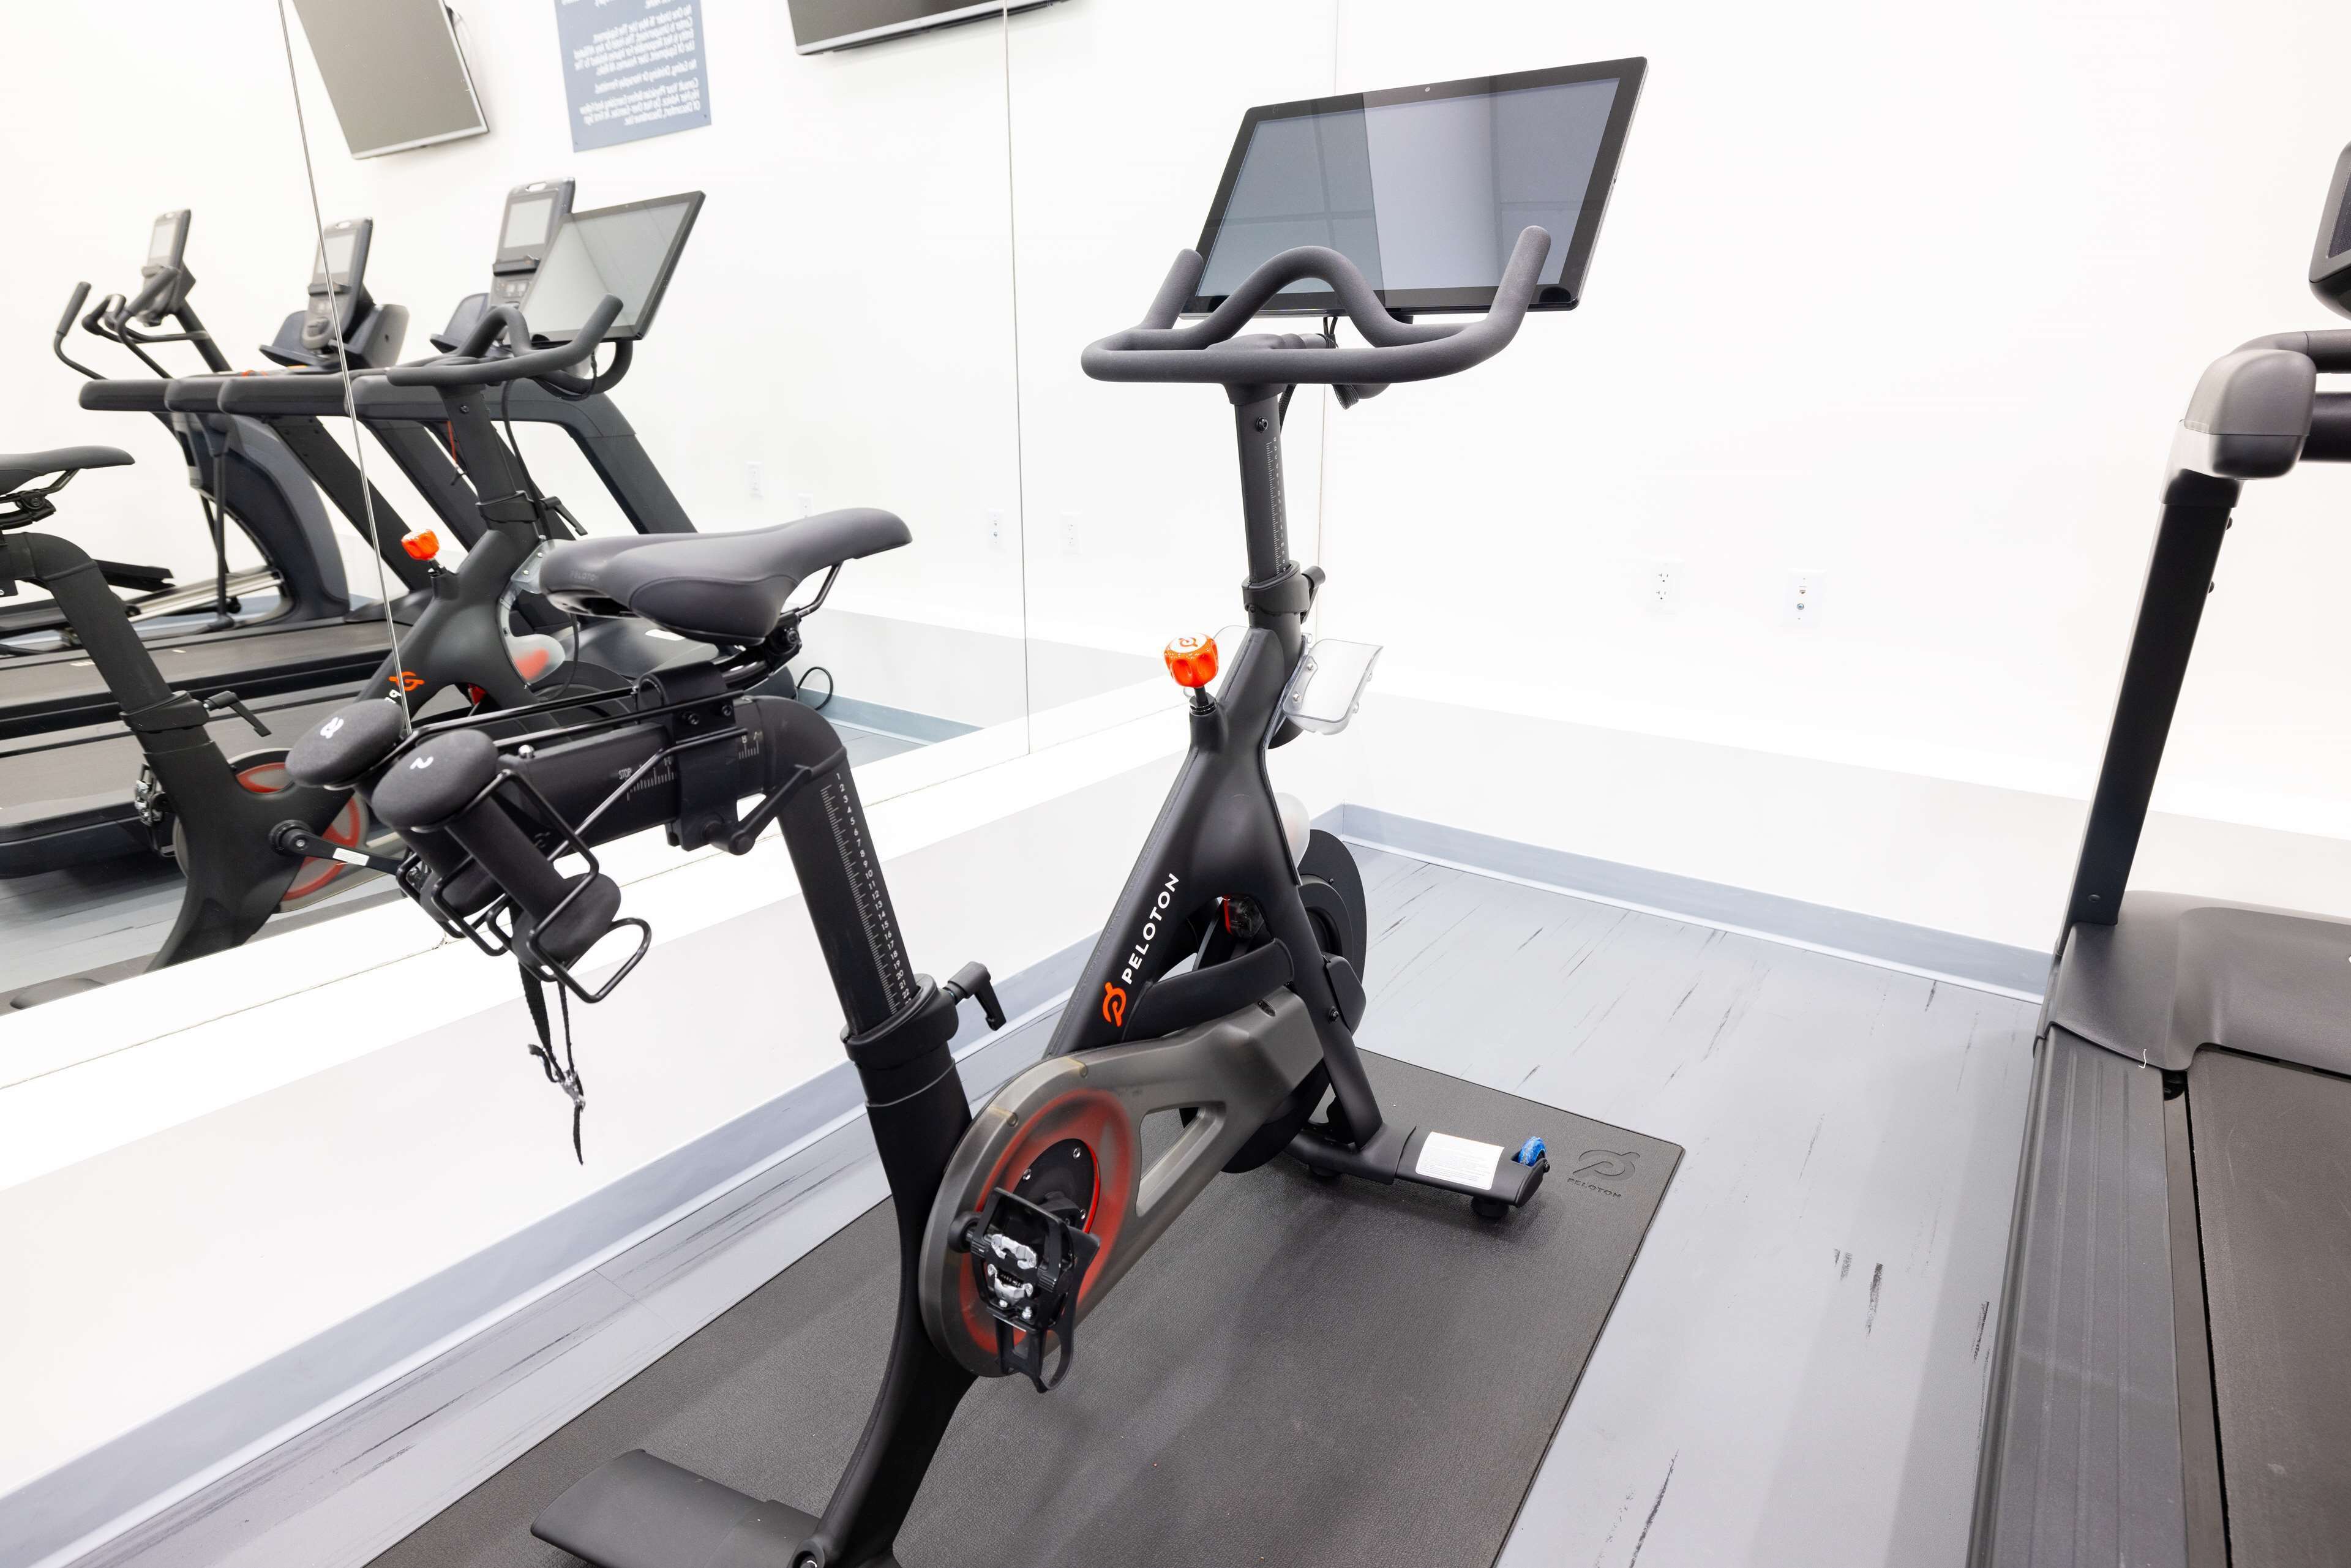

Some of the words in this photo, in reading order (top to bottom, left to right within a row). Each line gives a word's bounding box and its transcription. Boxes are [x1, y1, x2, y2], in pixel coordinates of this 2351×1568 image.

[618, 767, 632, 780] STOP
[839, 783, 845, 792] 2
[842, 795, 849, 803] 3
[850, 816, 855, 825] 5
[857, 838, 861, 847] 7
[860, 849, 865, 858] 8
[865, 869, 874, 880] 10
[868, 880, 876, 890] 11
[871, 890, 880, 900] 12
[874, 900, 883, 910] 13
[878, 910, 886, 921] 14
[881, 920, 889, 931] 15
[1121, 872, 1180, 985] PELOTON
[884, 931, 892, 940] 16
[887, 940, 894, 950] 17
[890, 950, 898, 960] 18
[893, 959, 901, 970] 19
[896, 969, 904, 980] 20
[899, 980, 906, 989] 21
[902, 988, 910, 999] 22
[1567, 1177, 1622, 1201] PELOTON
